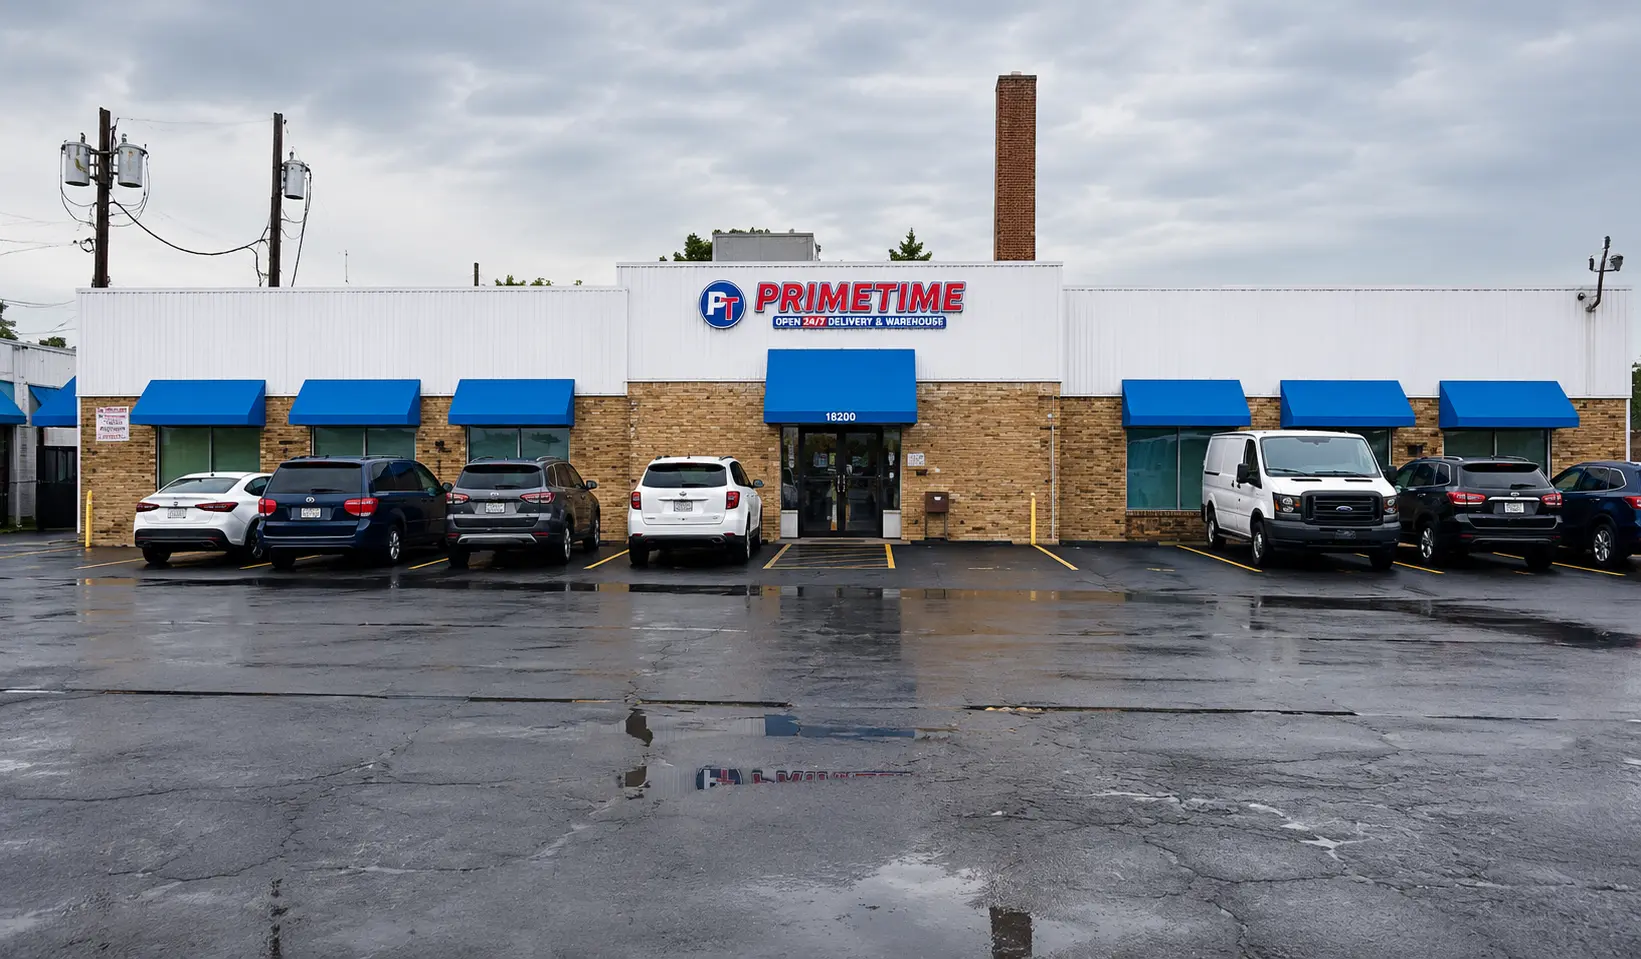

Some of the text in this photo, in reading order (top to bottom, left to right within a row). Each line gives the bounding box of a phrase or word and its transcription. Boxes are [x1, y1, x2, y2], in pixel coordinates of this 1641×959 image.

[706, 291, 740, 320] PT
[754, 281, 967, 314] PRIMETIME
[775, 317, 801, 326] OPEN
[802, 317, 826, 326] 24/7
[828, 317, 873, 326] DELIVERY
[875, 317, 883, 326] &
[825, 412, 856, 422] 18200
